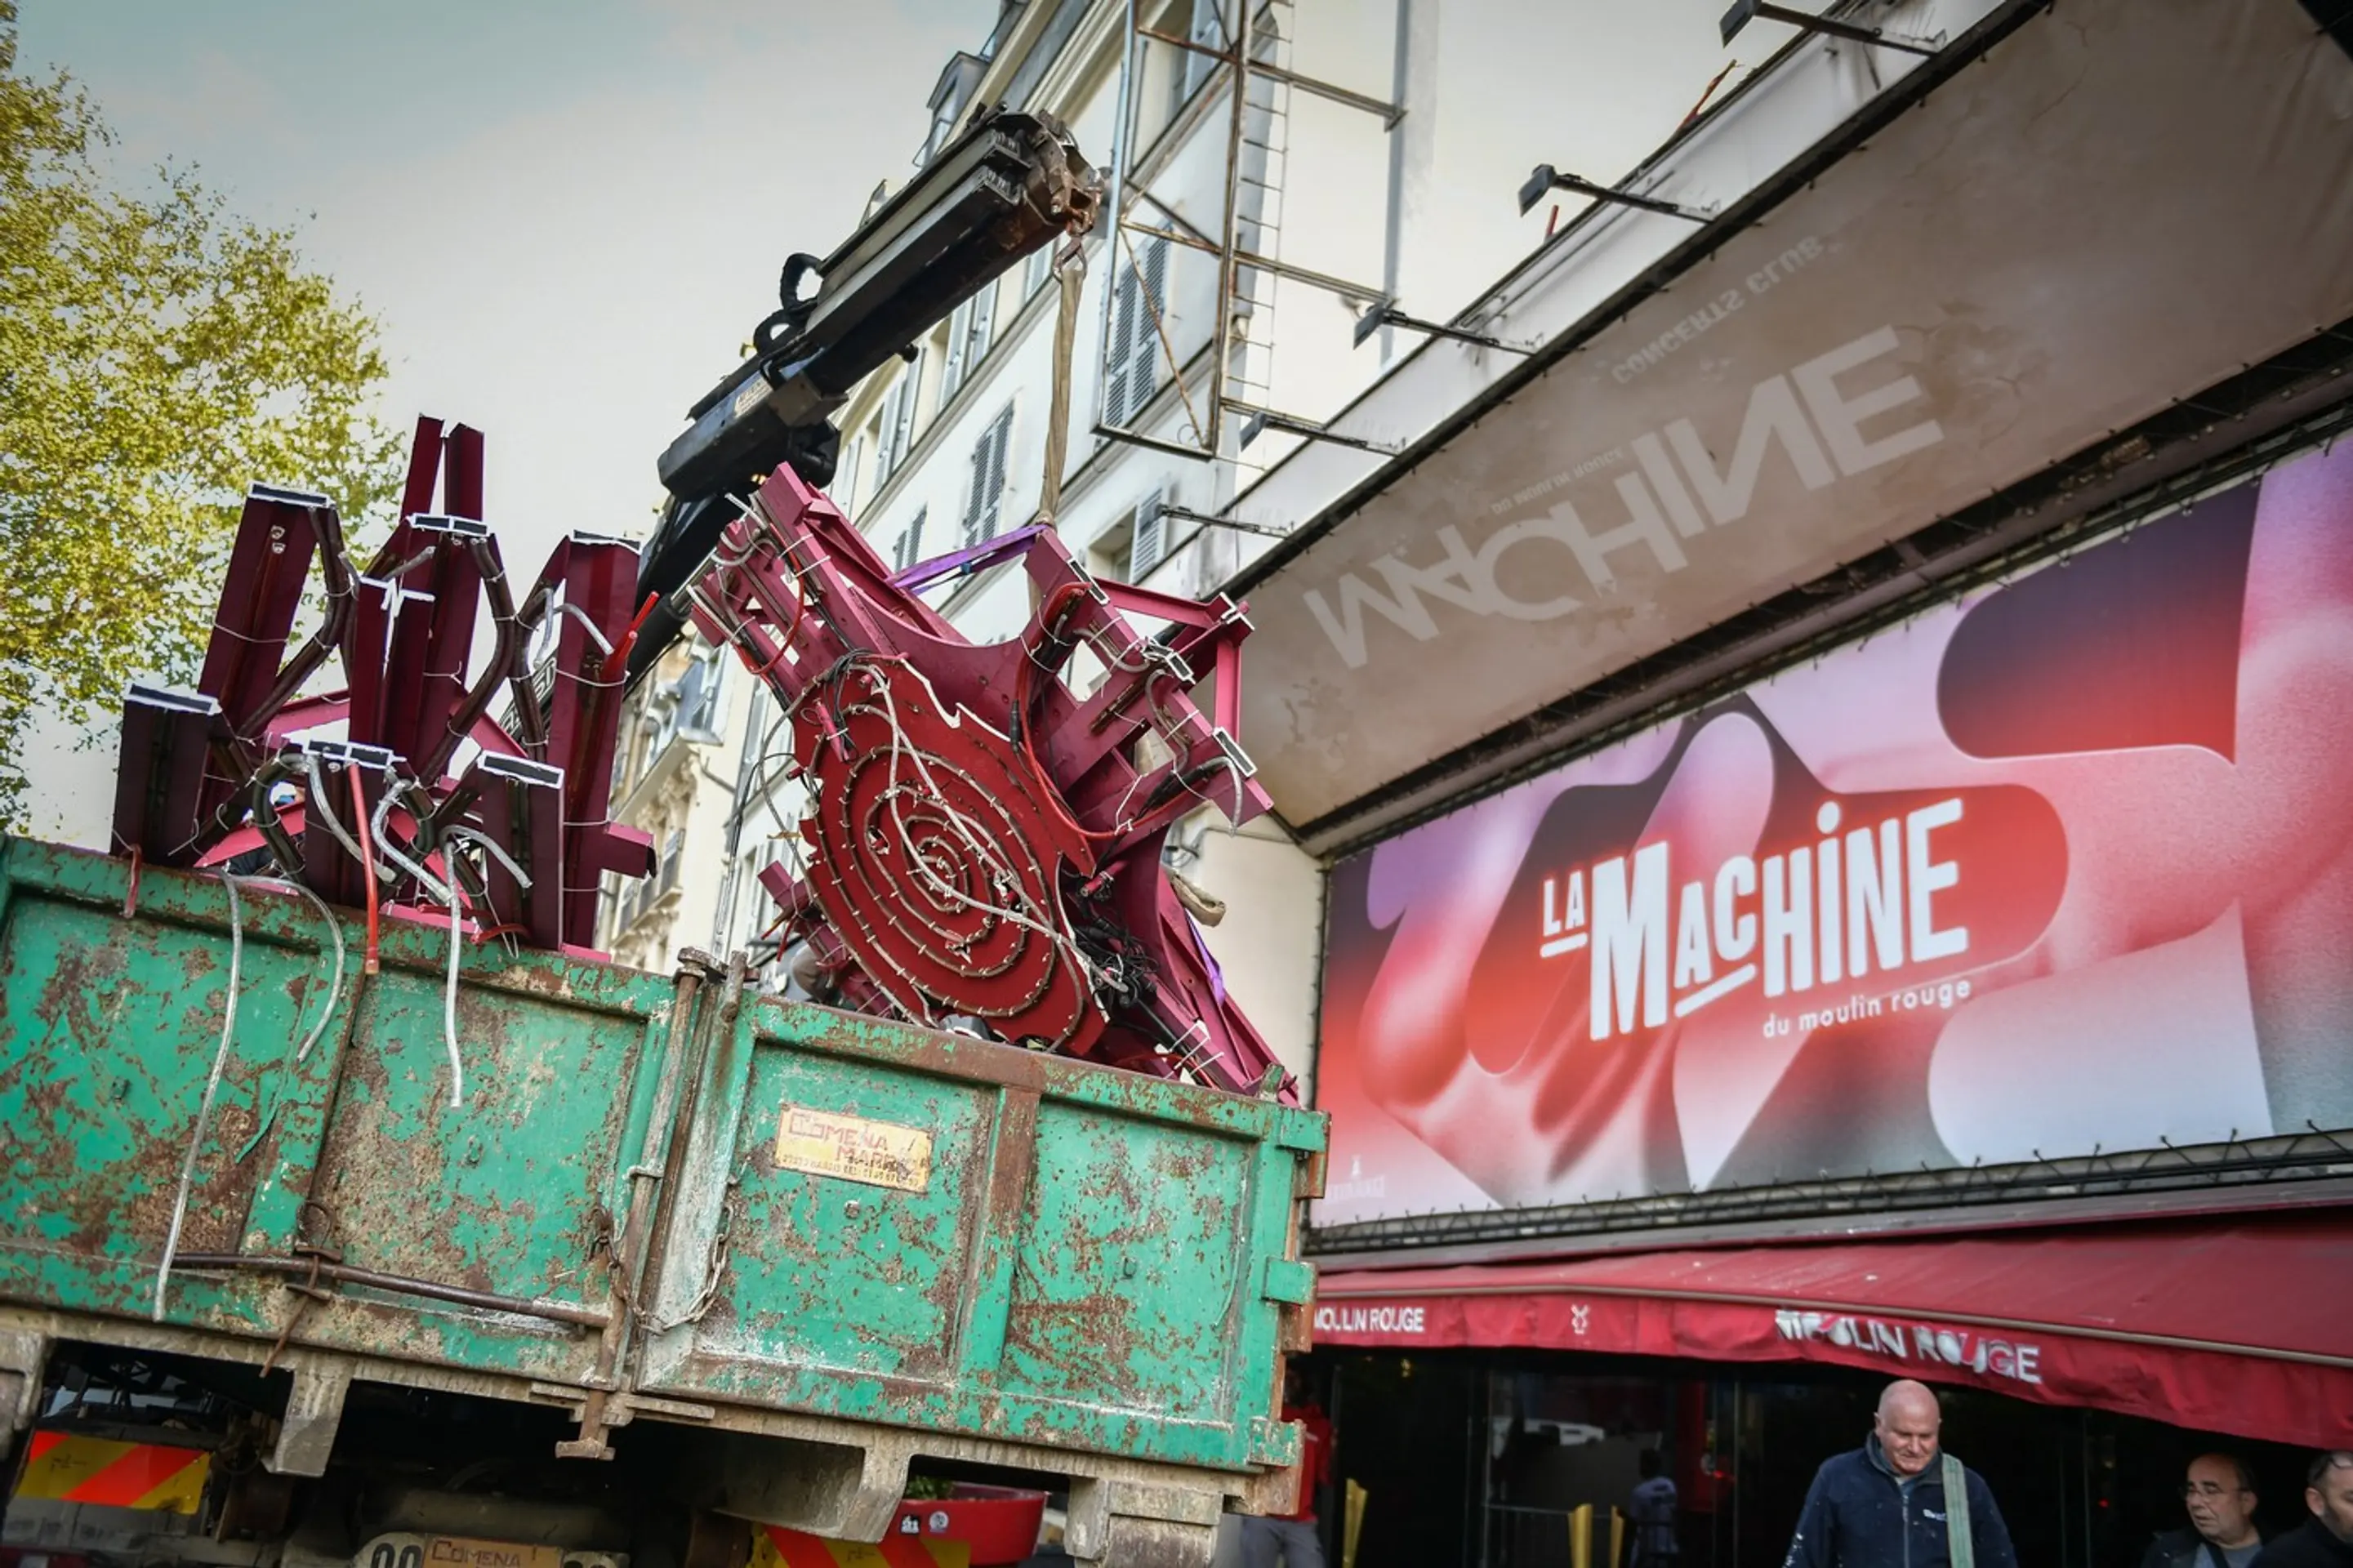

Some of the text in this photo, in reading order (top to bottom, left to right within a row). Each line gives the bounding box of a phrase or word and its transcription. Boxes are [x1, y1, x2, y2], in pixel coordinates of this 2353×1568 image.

[1543, 870, 1587, 937] LA
[1763, 980, 1971, 1039] du moulin rouge
[1370, 1307, 1425, 1332] ROUGE
[1912, 1325, 2042, 1383] ROUGE
